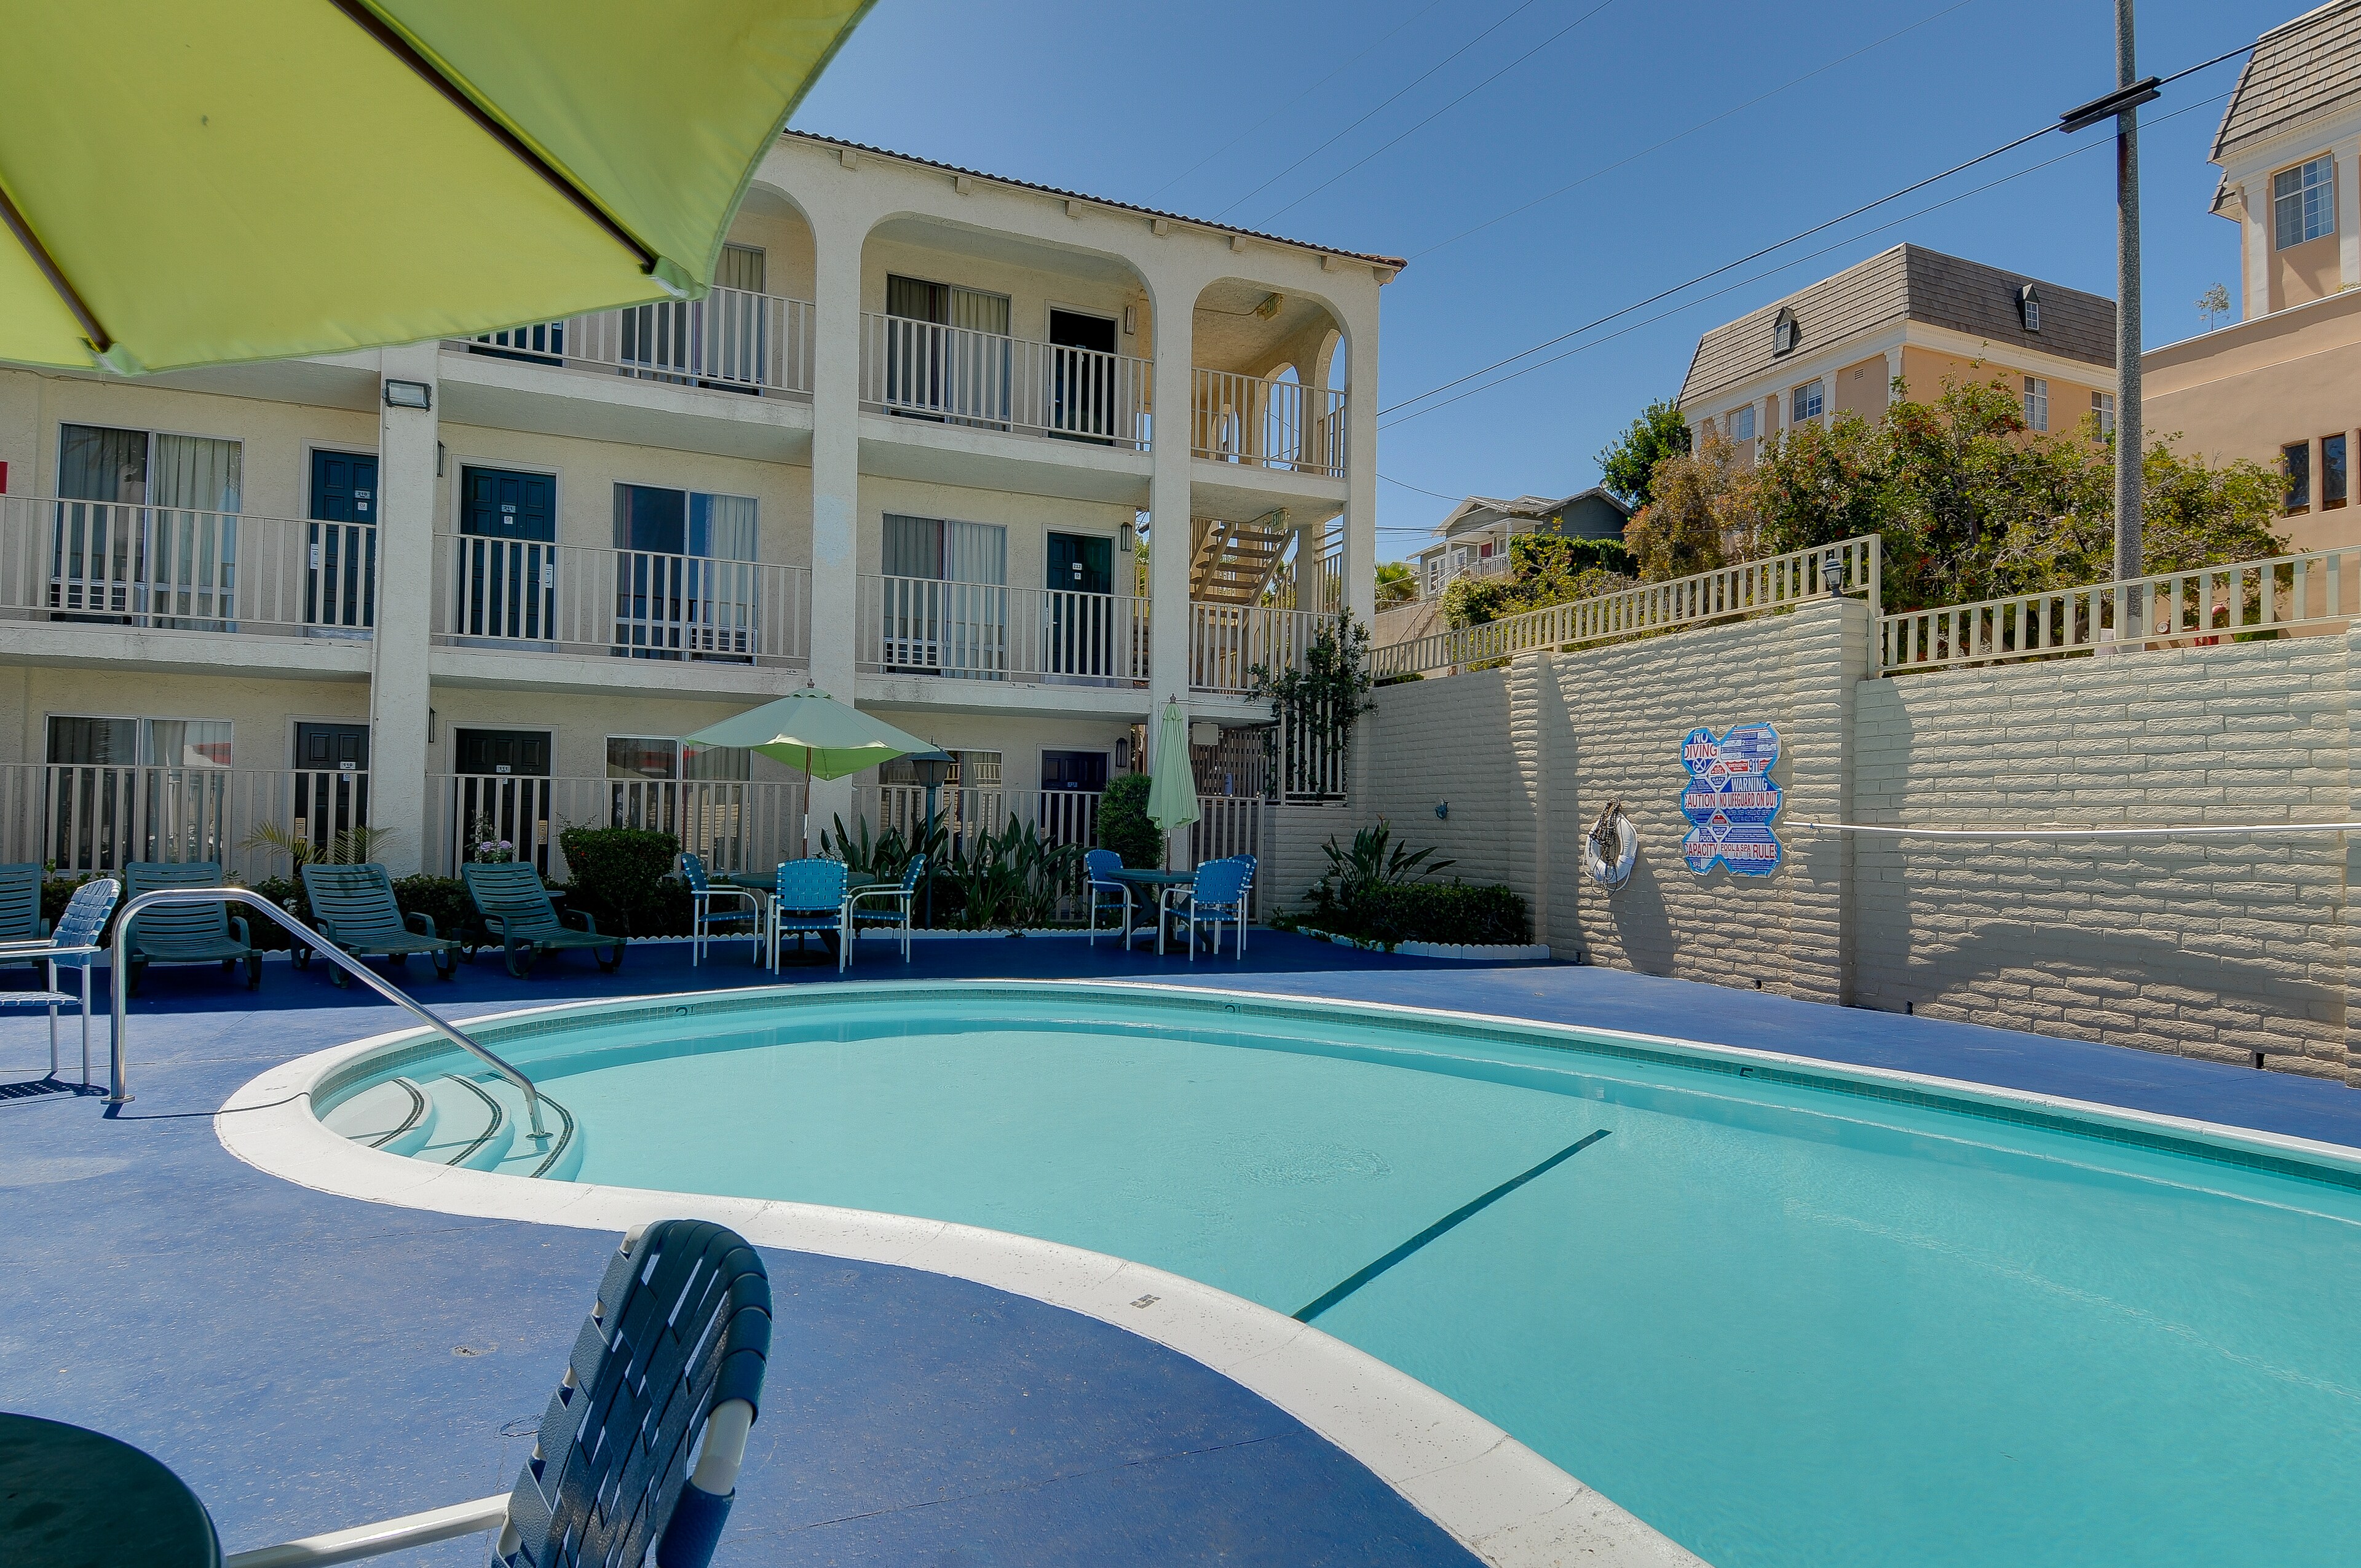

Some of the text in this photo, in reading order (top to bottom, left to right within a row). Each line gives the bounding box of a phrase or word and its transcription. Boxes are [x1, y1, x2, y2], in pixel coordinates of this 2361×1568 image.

[1693, 734, 1707, 744] NO
[1685, 745, 1717, 759] DIVING
[1749, 759, 1759, 773] 911
[1731, 777, 1767, 792] WARNING
[1719, 792, 1776, 807] NO LIFEGUARD ON DUT
[1685, 844, 1717, 857] CAPACITY
[1753, 845, 1776, 858] RULES
